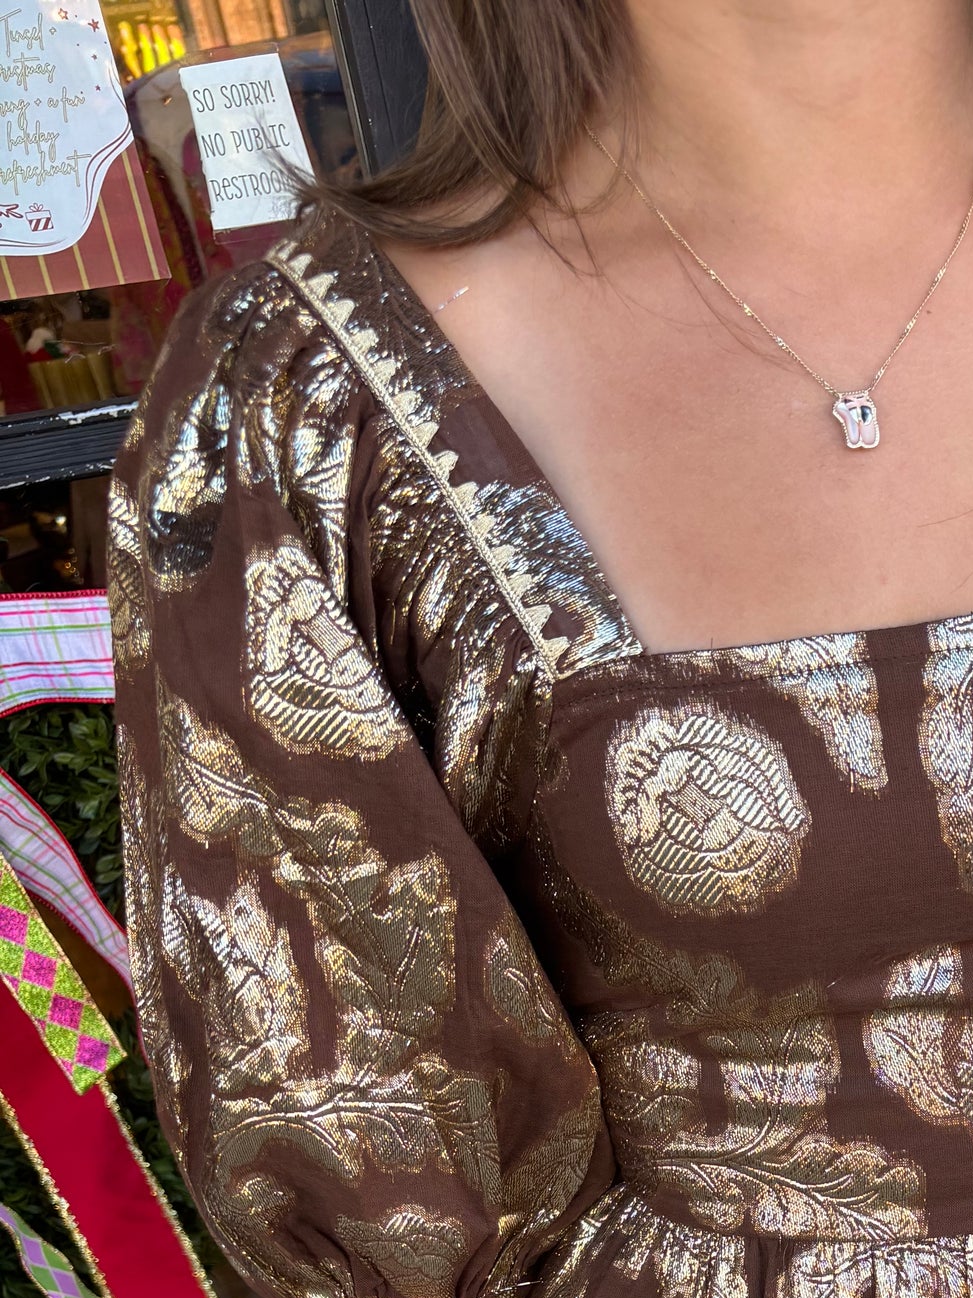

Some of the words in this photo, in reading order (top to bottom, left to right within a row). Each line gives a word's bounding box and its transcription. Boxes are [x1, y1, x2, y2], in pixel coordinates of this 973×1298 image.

[192, 88, 215, 113] SO
[220, 80, 276, 109] SORRY!
[7, 120, 60, 163] holiday
[201, 132, 226, 158] NO
[230, 123, 290, 154] PUBLIC
